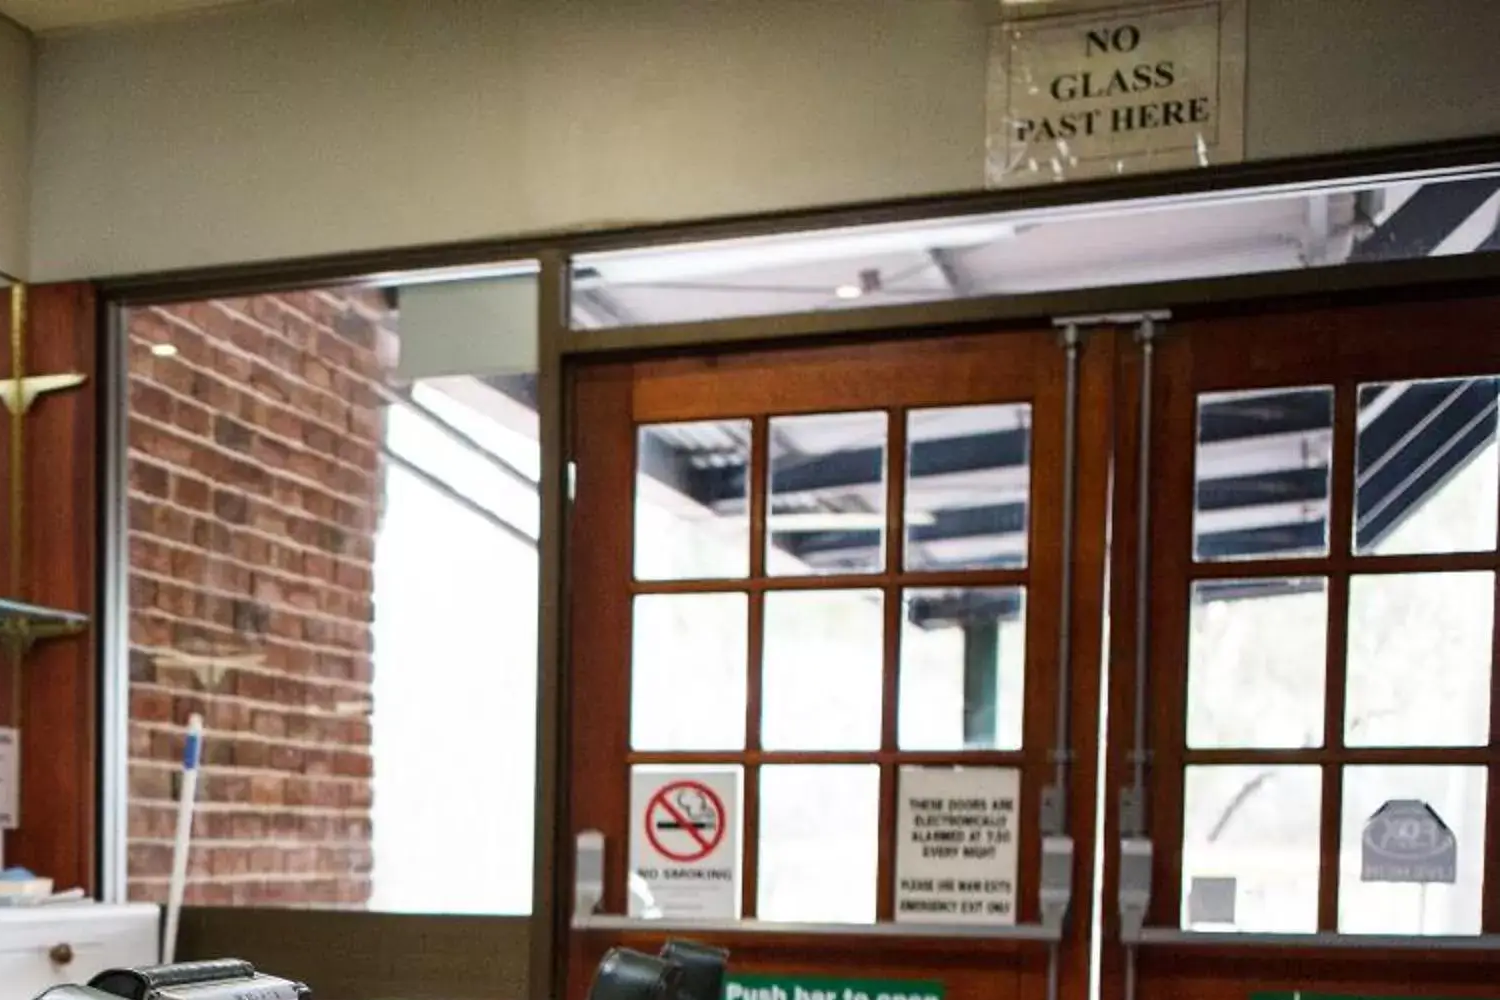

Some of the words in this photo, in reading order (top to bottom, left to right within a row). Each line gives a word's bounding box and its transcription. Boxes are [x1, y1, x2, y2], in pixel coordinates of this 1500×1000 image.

[1085, 24, 1141, 57] NO
[1050, 61, 1175, 101] GLASS
[1015, 109, 1100, 142] PAST
[1111, 96, 1209, 133] HERE
[909, 798, 943, 811] THESE
[948, 798, 987, 811] DOORS
[992, 799, 1014, 812] ARE
[911, 830, 965, 843] ALARMED
[969, 831, 982, 843] AT
[922, 845, 959, 859] EVERY
[638, 868, 659, 879] NO
[663, 868, 733, 881] SMOKING
